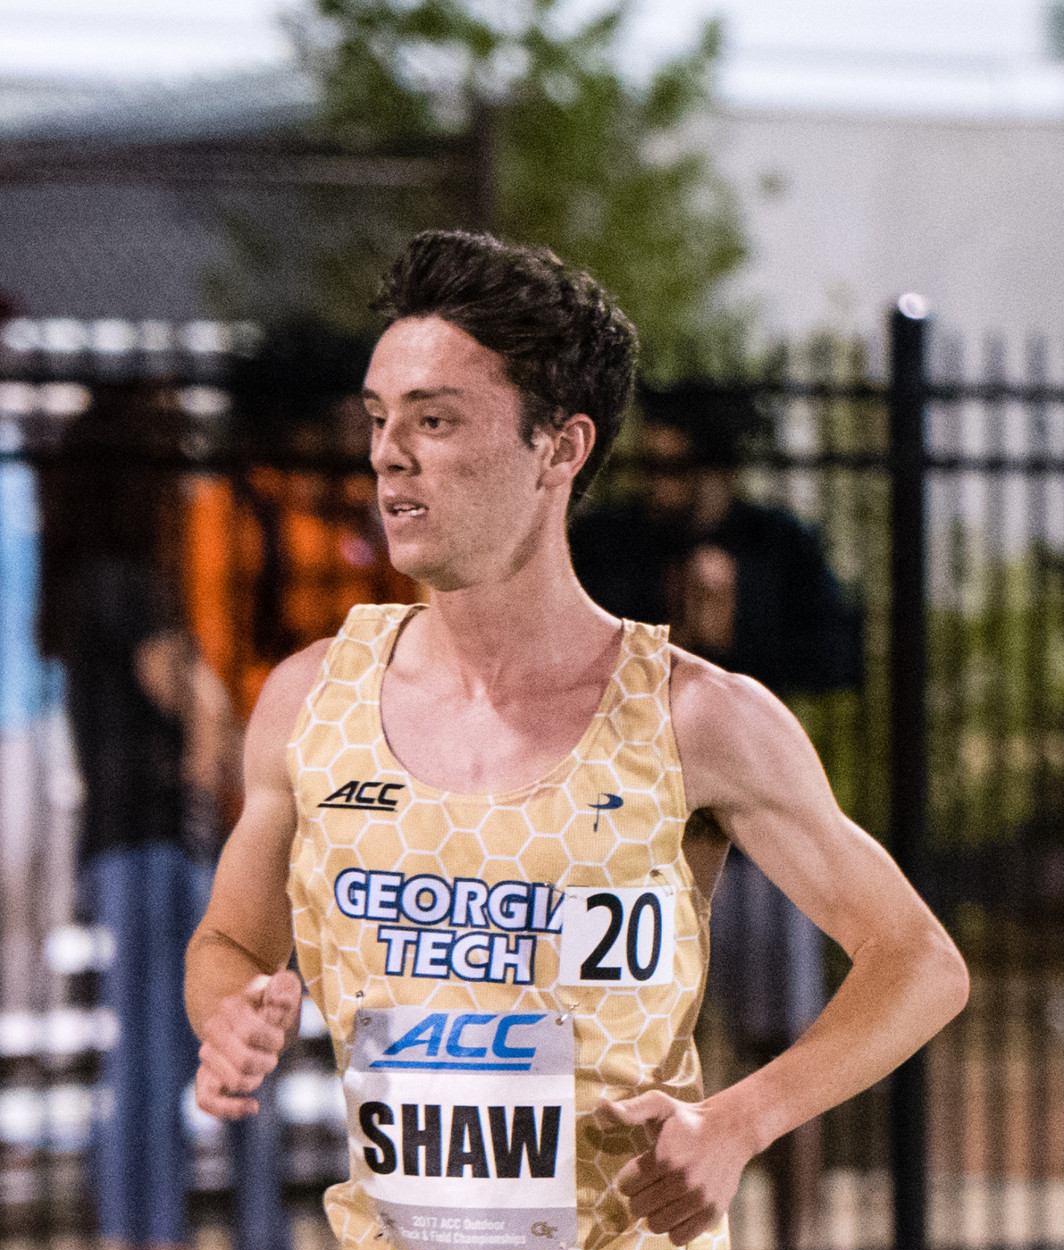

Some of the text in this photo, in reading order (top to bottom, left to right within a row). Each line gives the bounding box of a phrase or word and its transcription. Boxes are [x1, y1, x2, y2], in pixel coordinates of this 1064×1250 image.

[325, 780, 406, 806] ACC
[377, 926, 537, 985] TECH
[579, 891, 663, 981] 20
[382, 1013, 548, 1059] ACC
[358, 1101, 563, 1179] SHAW
[412, 1215, 437, 1227] 2017
[440, 1217, 461, 1230] ACC
